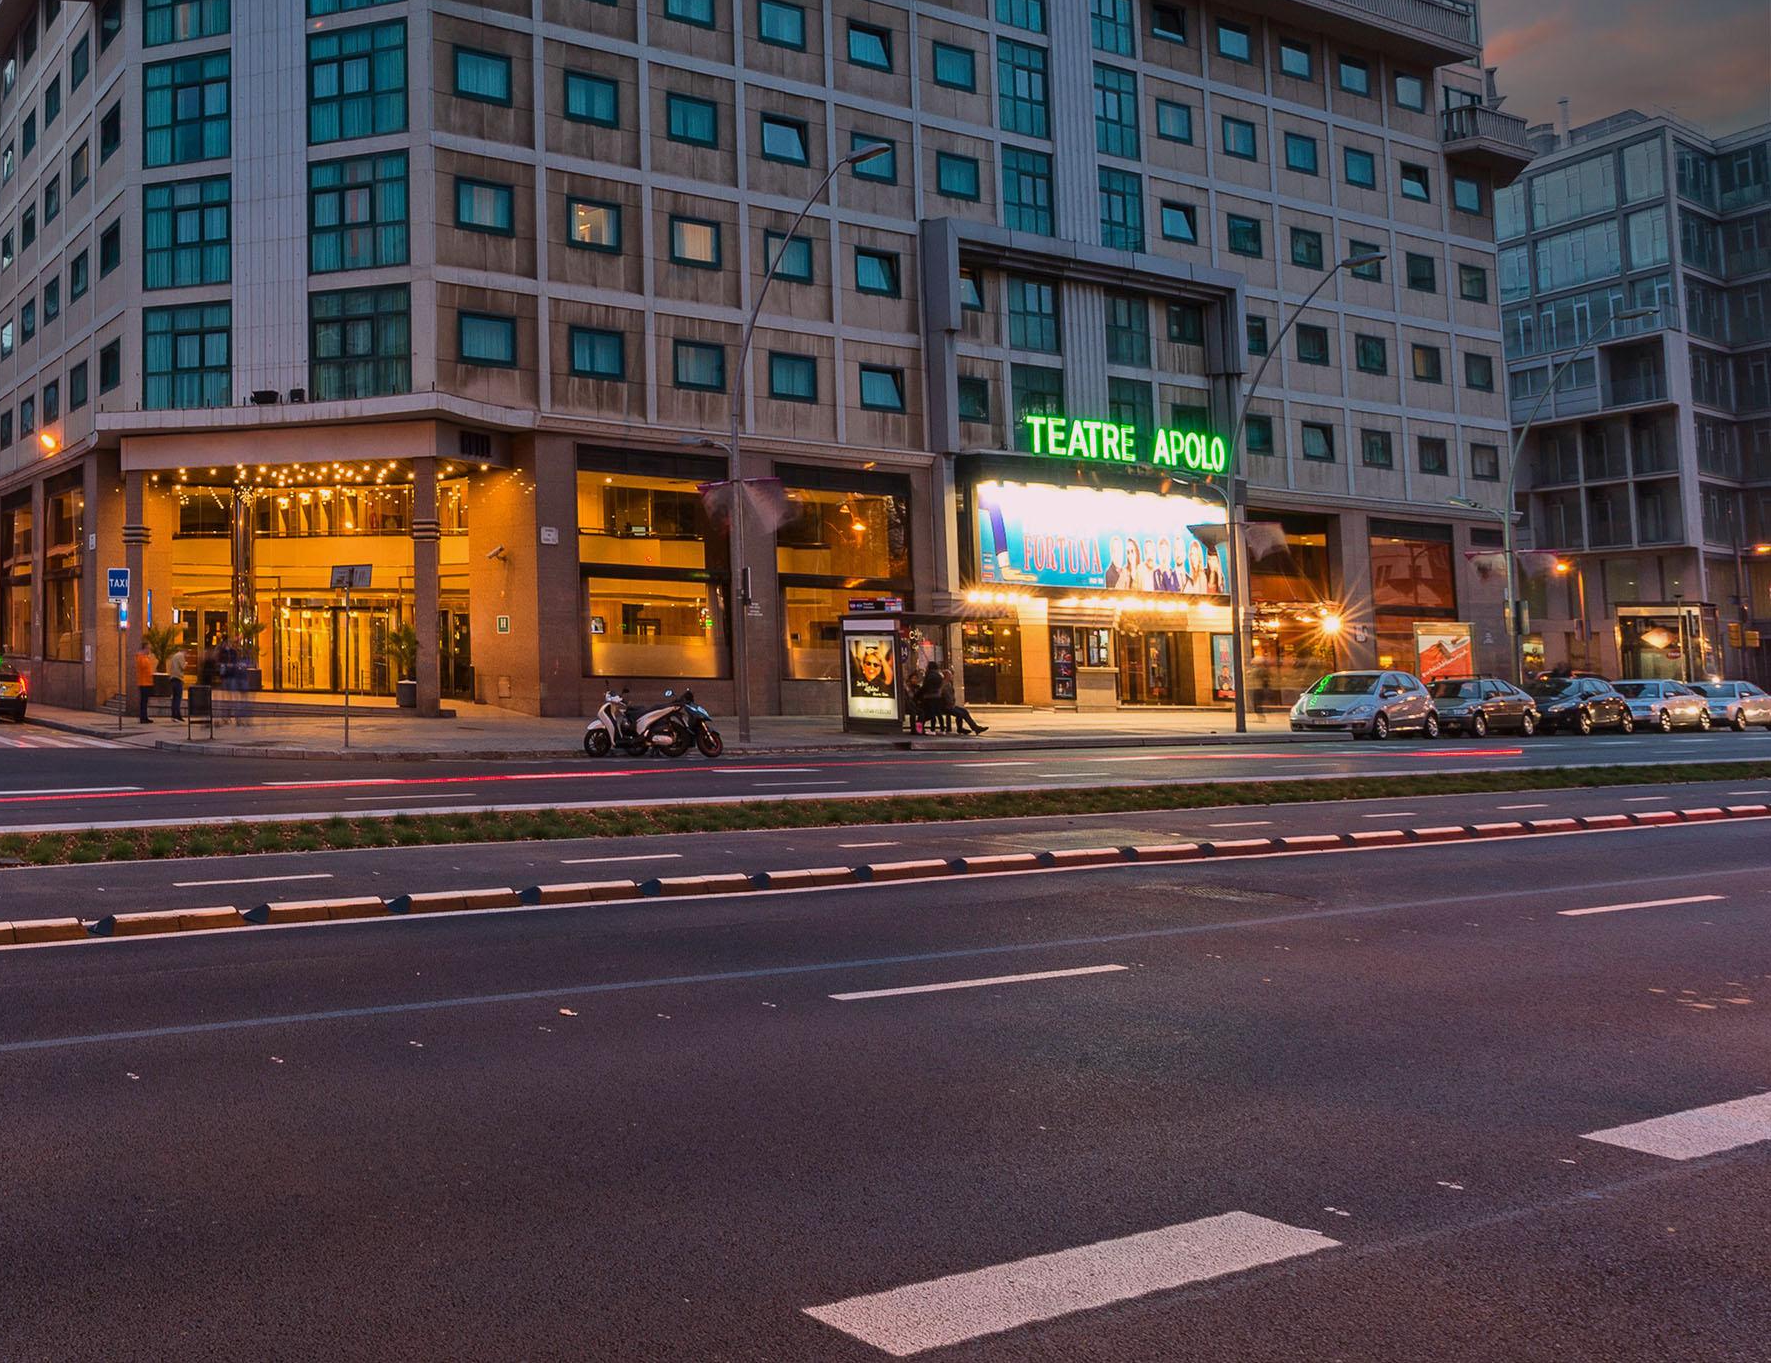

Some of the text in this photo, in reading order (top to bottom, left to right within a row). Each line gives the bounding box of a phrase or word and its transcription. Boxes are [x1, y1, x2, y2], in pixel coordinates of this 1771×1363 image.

[1025, 415, 1226, 473] TEATRE APOLO
[1023, 533, 1103, 575] FORTUNA
[109, 579, 128, 588] TAXI
